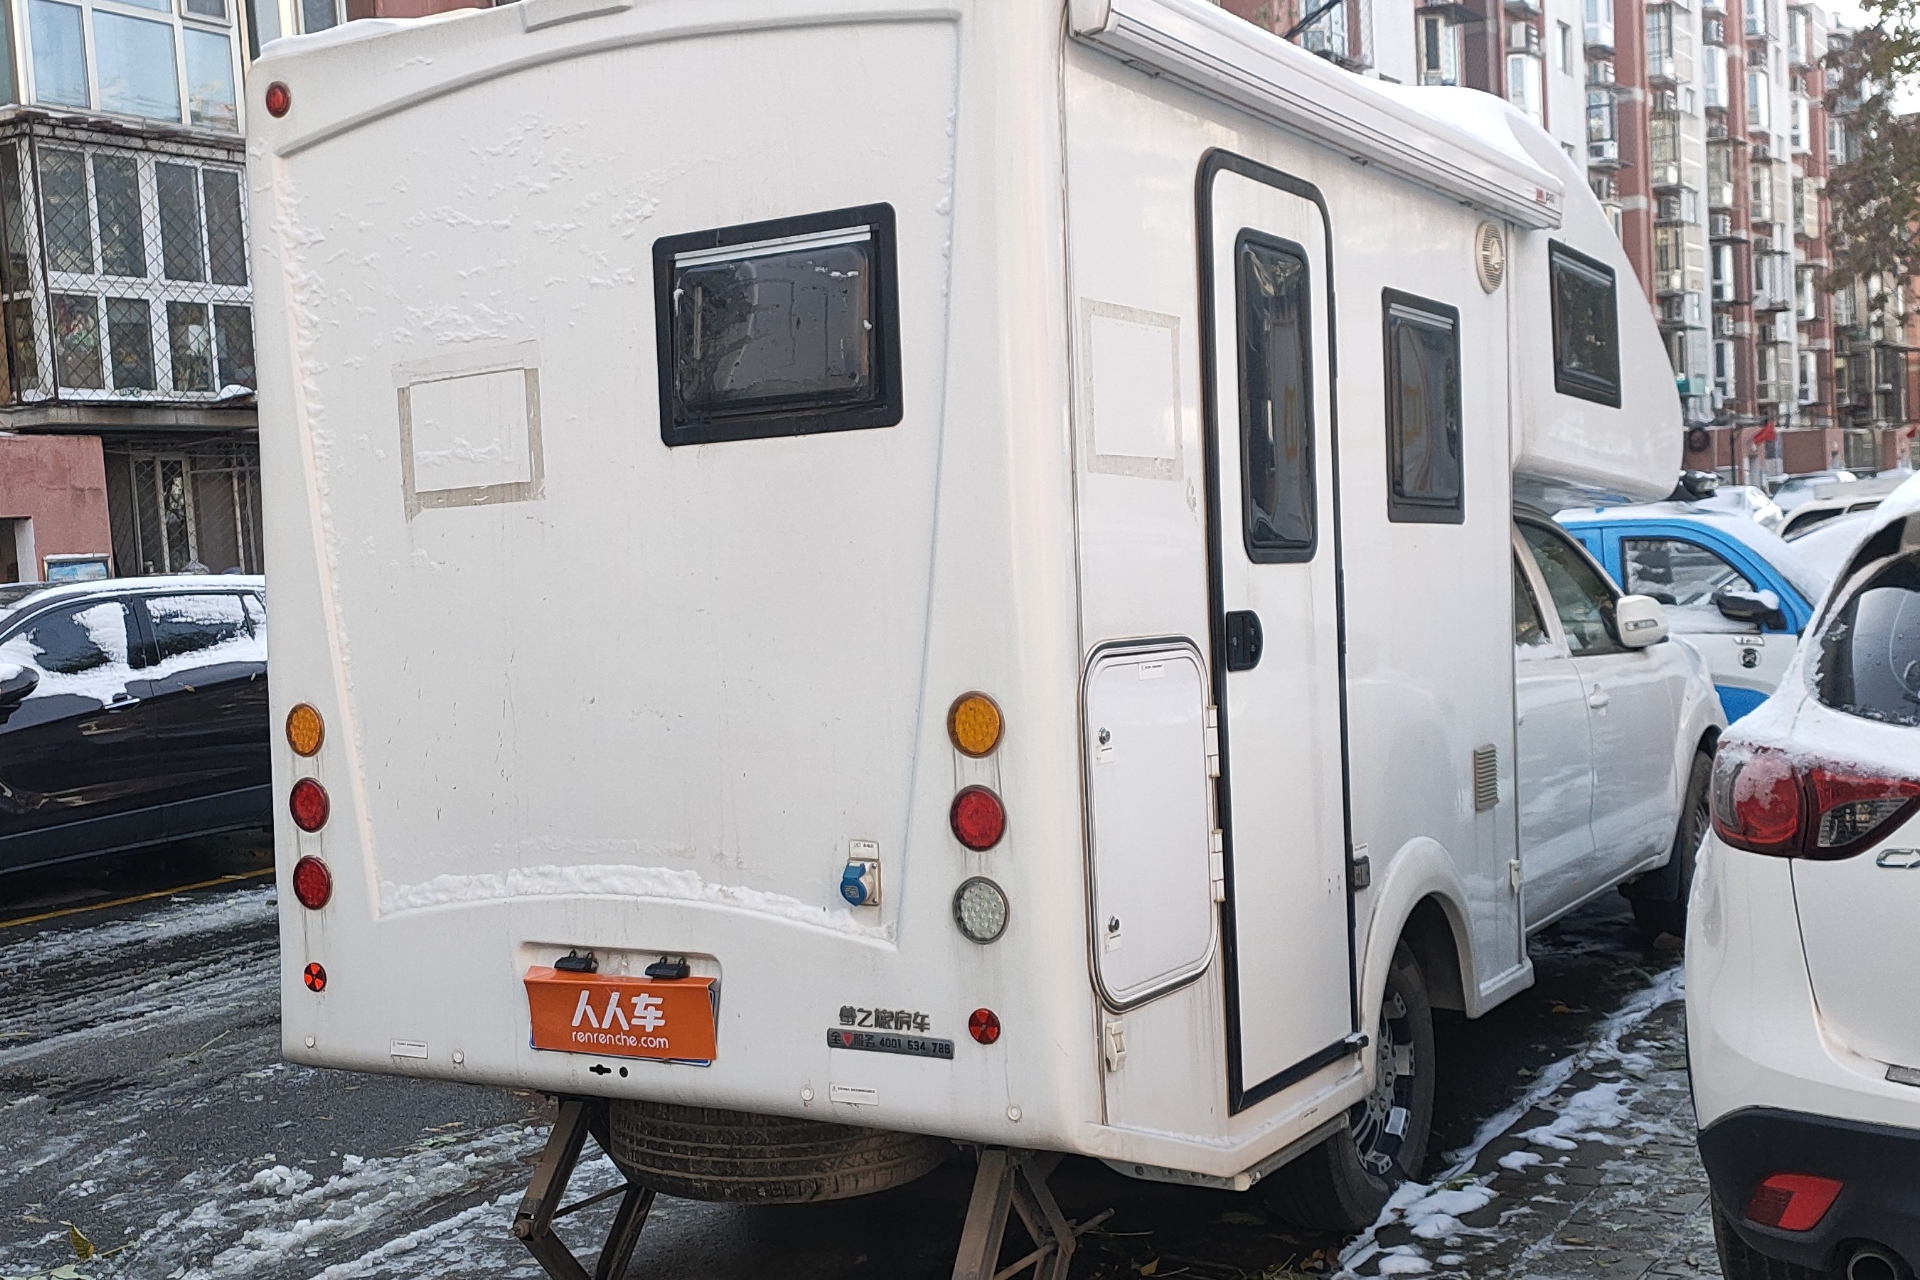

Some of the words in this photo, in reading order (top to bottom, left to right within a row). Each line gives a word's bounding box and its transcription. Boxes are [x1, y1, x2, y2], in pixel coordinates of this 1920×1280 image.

[571, 990, 666, 1033] 人人车
[572, 1031, 669, 1049] renrenche.com
[879, 1036, 902, 1049] 4001
[907, 1040, 926, 1052] 534
